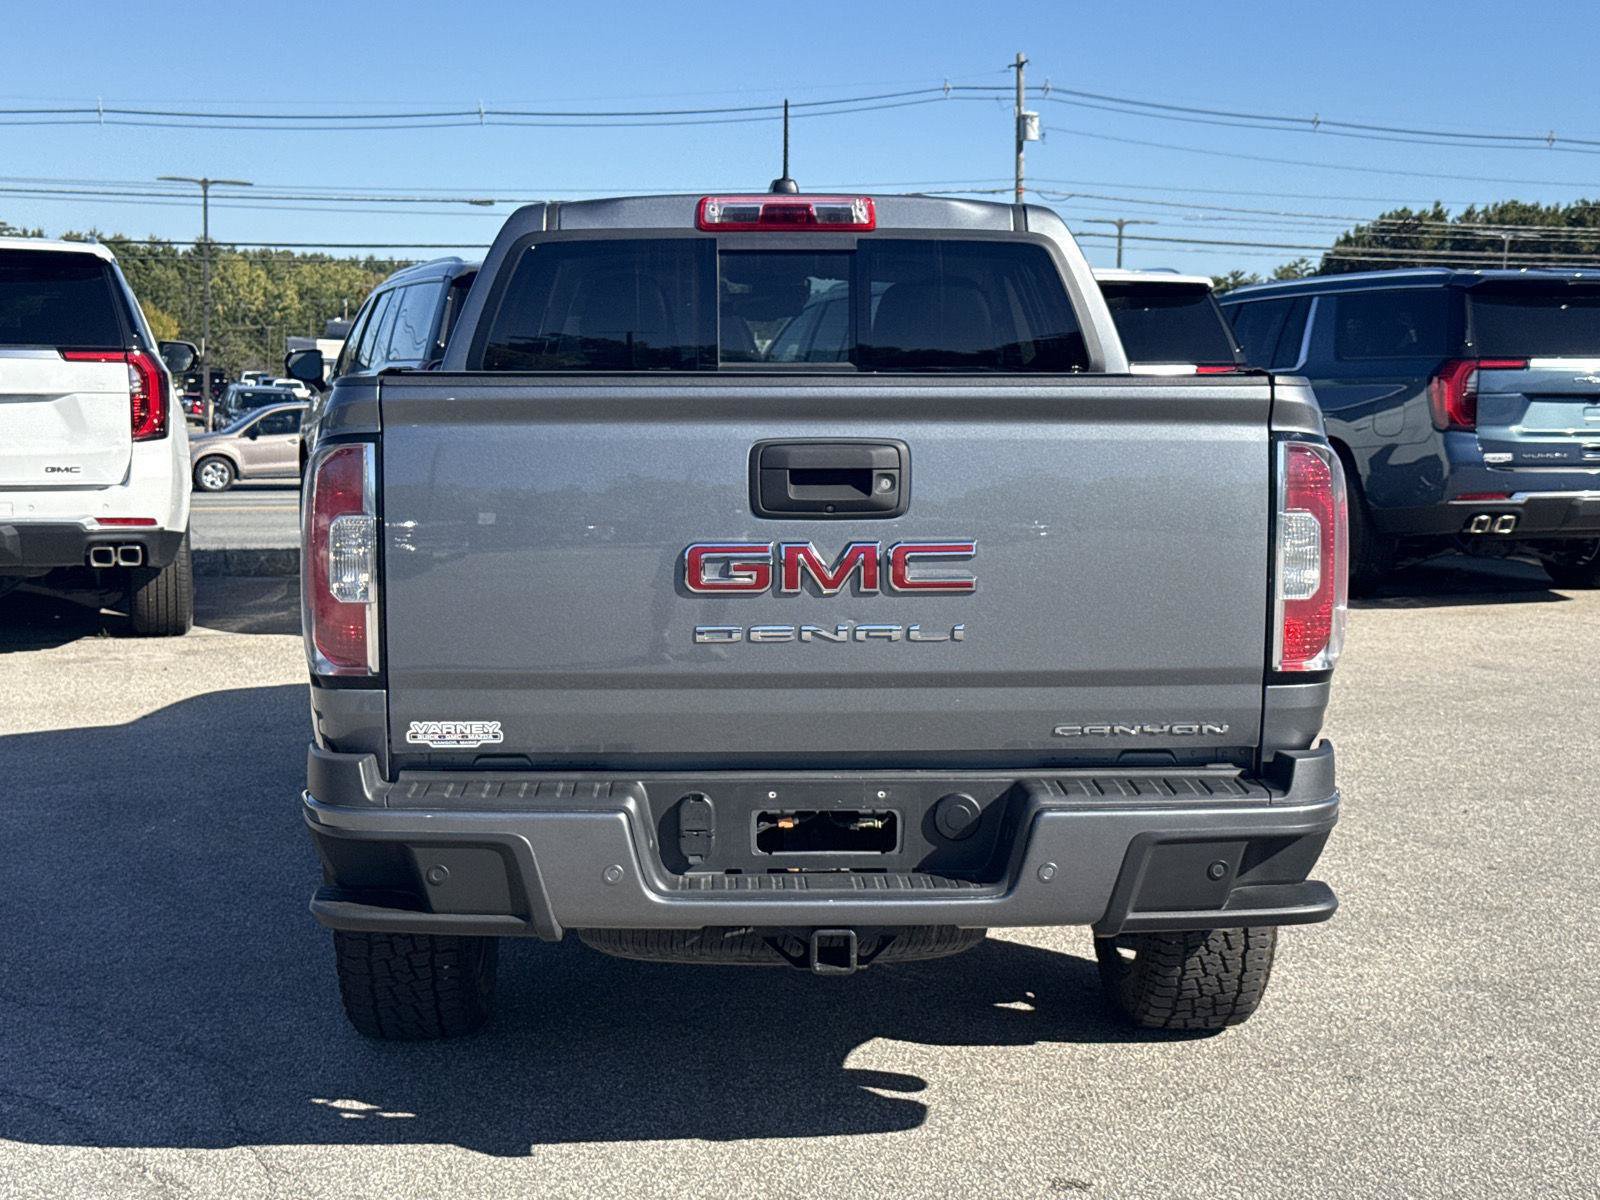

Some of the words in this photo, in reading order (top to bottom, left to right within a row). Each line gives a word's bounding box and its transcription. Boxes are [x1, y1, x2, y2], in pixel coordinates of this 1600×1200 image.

[684, 540, 978, 594] GMC
[695, 624, 965, 643] DENALI
[411, 722, 499, 734] VARNEY
[1054, 723, 1230, 736] CANYON
